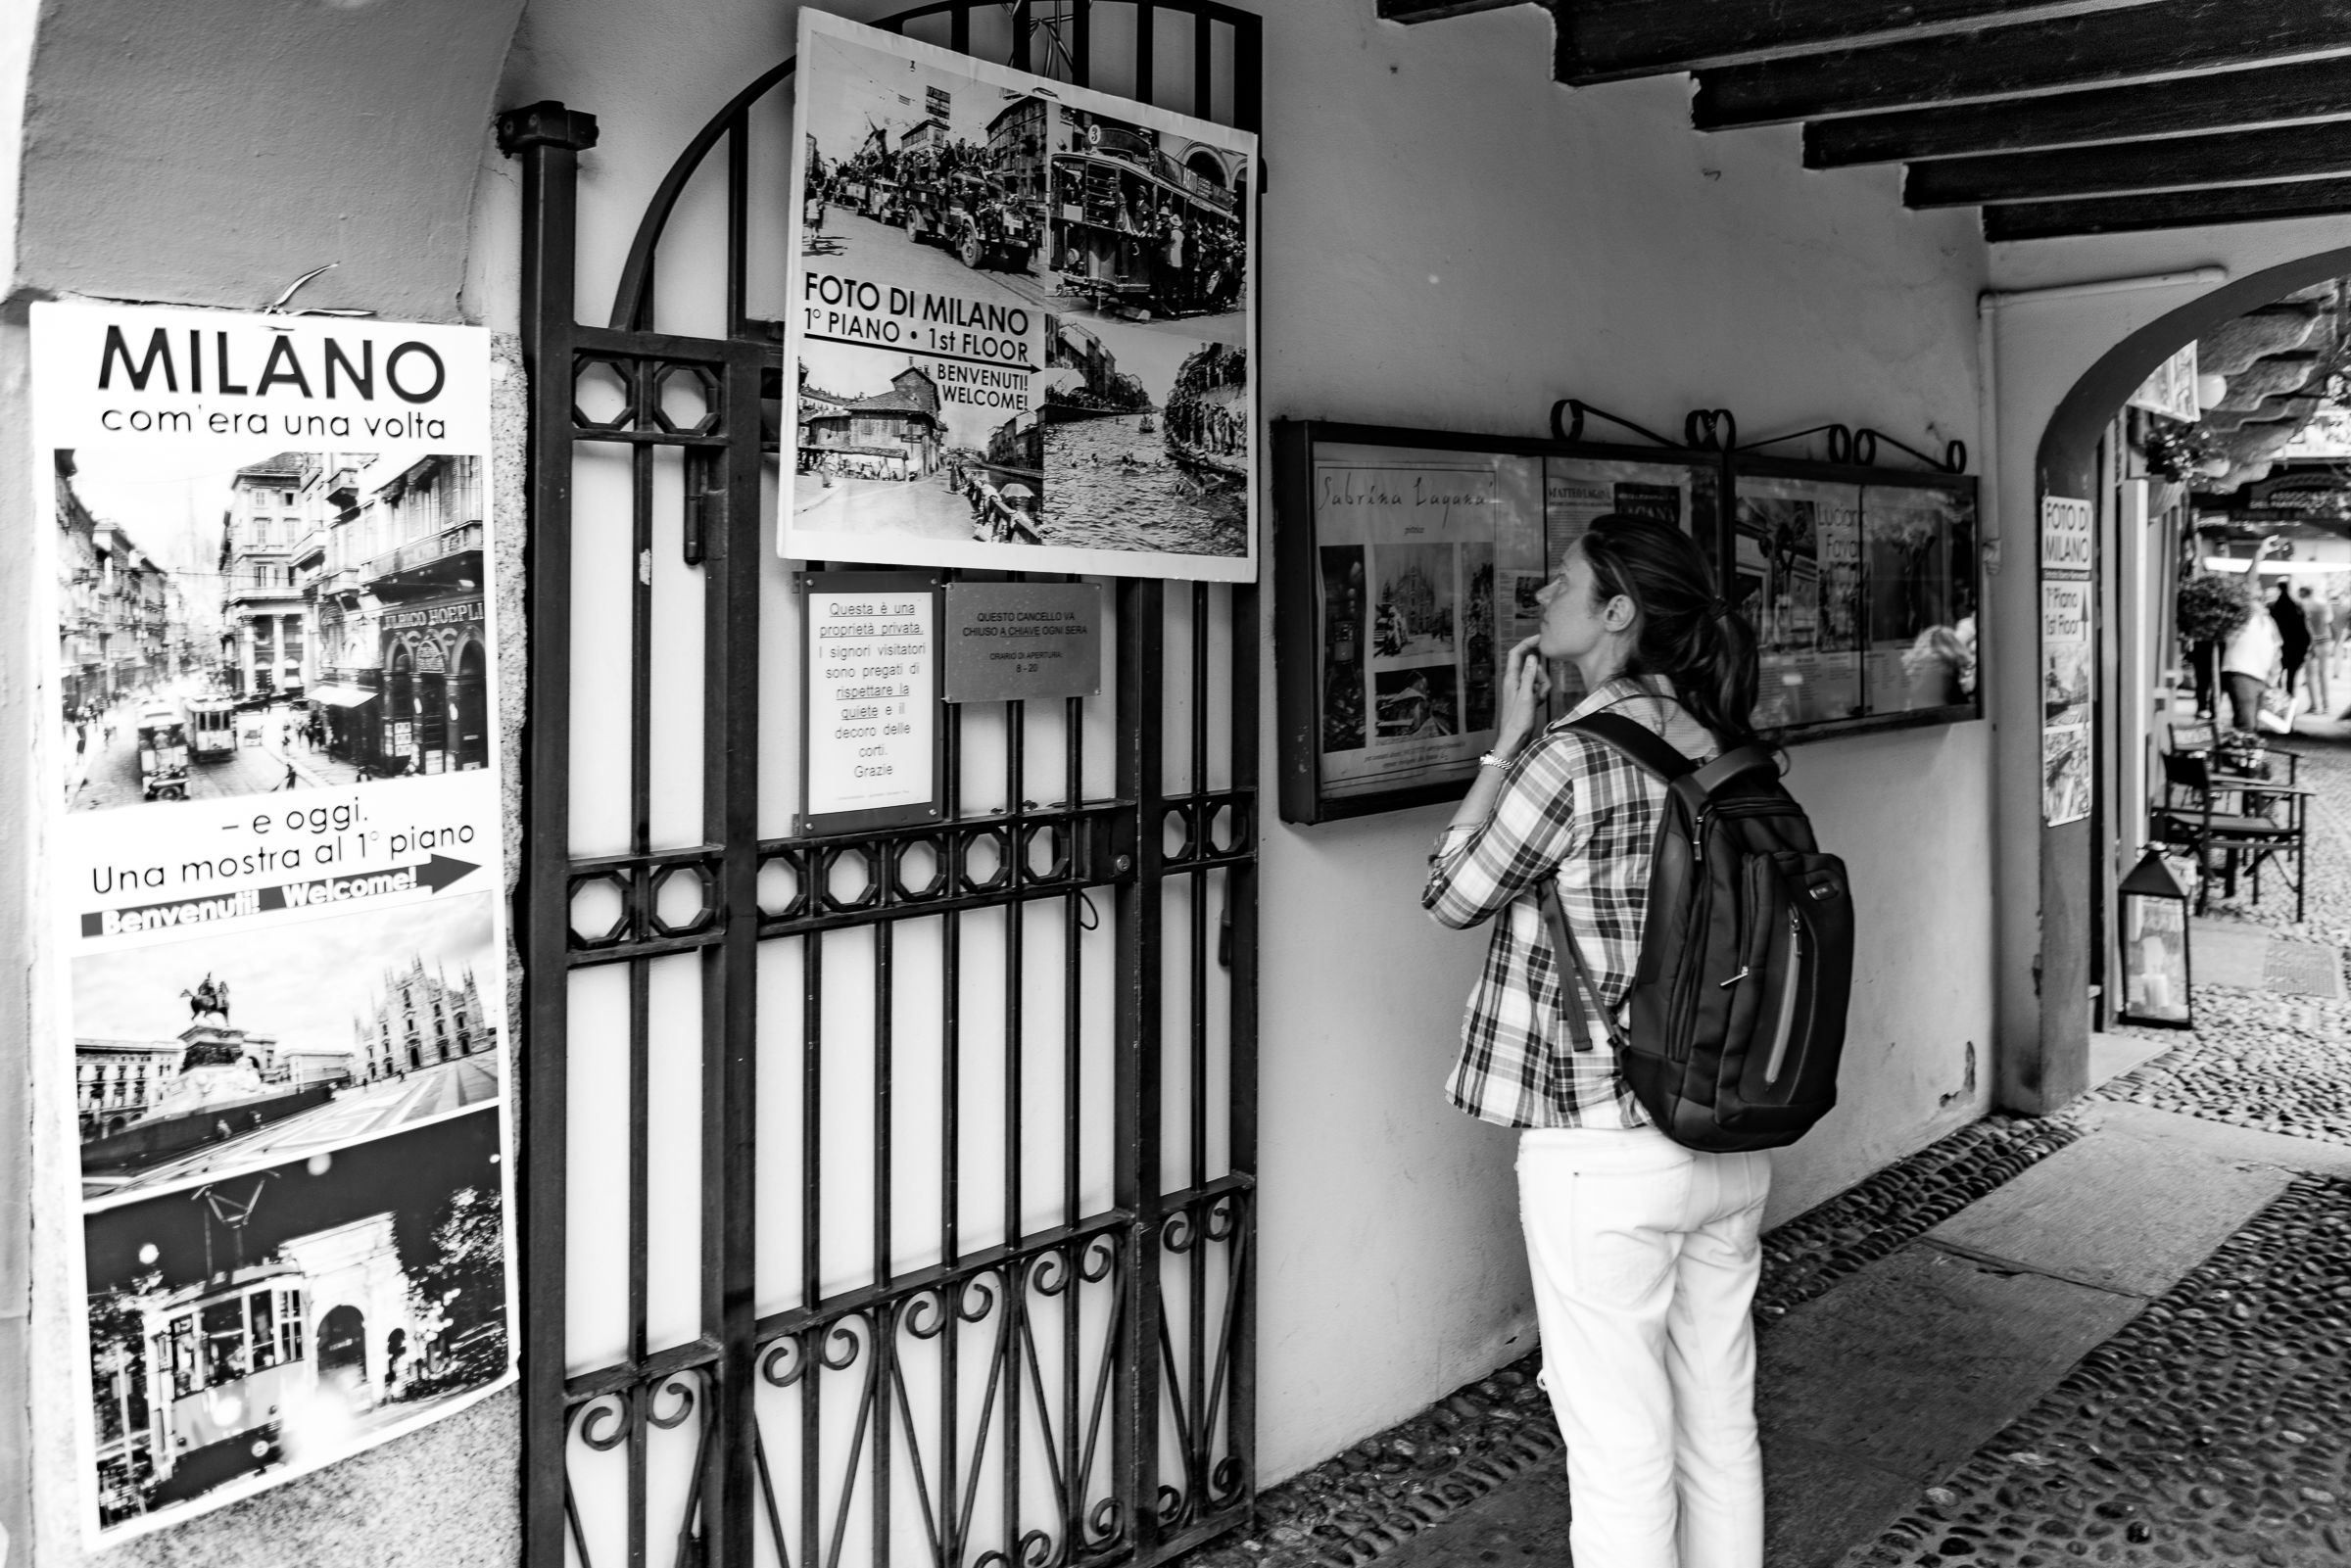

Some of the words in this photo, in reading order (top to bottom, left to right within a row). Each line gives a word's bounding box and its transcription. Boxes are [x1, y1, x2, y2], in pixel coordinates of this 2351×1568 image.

[805, 271, 881, 310] FOTO
[889, 286, 914, 317] DI
[922, 293, 1029, 336] MILANO
[829, 310, 900, 343] PIANO
[929, 327, 956, 352] 1st
[962, 333, 1029, 362] FLOOR
[97, 324, 447, 404] MILANO
[936, 363, 1029, 392] BENVENUTI!
[941, 385, 1029, 411] WELCOME!
[101, 404, 268, 434] com'era
[284, 413, 350, 437] una
[363, 410, 446, 440] volta
[1317, 471, 1402, 511] Sabrina
[2045, 502, 2076, 531] FOTO
[2080, 506, 2089, 533] DI
[2044, 535, 2088, 563] MILANO
[428, 602, 485, 627] HOEPLI
[829, 602, 874, 616] Questa
[880, 602, 888, 615] è
[893, 603, 916, 615] una
[977, 612, 1016, 622] QUESTO
[1016, 611, 1063, 622] CANCELLO
[1064, 611, 1076, 621] VA
[819, 623, 875, 638] proprietà
[881, 621, 924, 637] privata.
[962, 627, 999, 637] CHIUSO
[999, 627, 1007, 636] A
[1007, 626, 1040, 637] CHIAVE
[1041, 626, 1064, 636] OGNI
[1064, 625, 1088, 635] SERA
[830, 644, 872, 661] signori
[877, 642, 927, 656] visitatori
[988, 651, 1017, 660] ORARIO
[1017, 651, 1025, 660] DI
[826, 667, 856, 679] sono
[862, 663, 904, 680] pregati
[909, 662, 921, 676] di
[1028, 662, 1038, 673] 20
[836, 685, 894, 699] rispettare
[899, 683, 910, 696] la
[840, 704, 879, 720] quiete
[885, 704, 893, 716] e
[898, 702, 906, 715] il
[834, 725, 877, 739] decoro
[883, 722, 912, 736] delle
[858, 744, 888, 758] corti.
[853, 764, 894, 779] Grazie
[252, 814, 272, 834] e
[285, 795, 369, 834] oggi.
[92, 865, 166, 895] Una
[182, 847, 301, 883] mostra
[314, 835, 343, 865] al
[391, 824, 475, 861] piano
[100, 890, 262, 936] Benvenuti!
[281, 866, 419, 909] Welcome!
